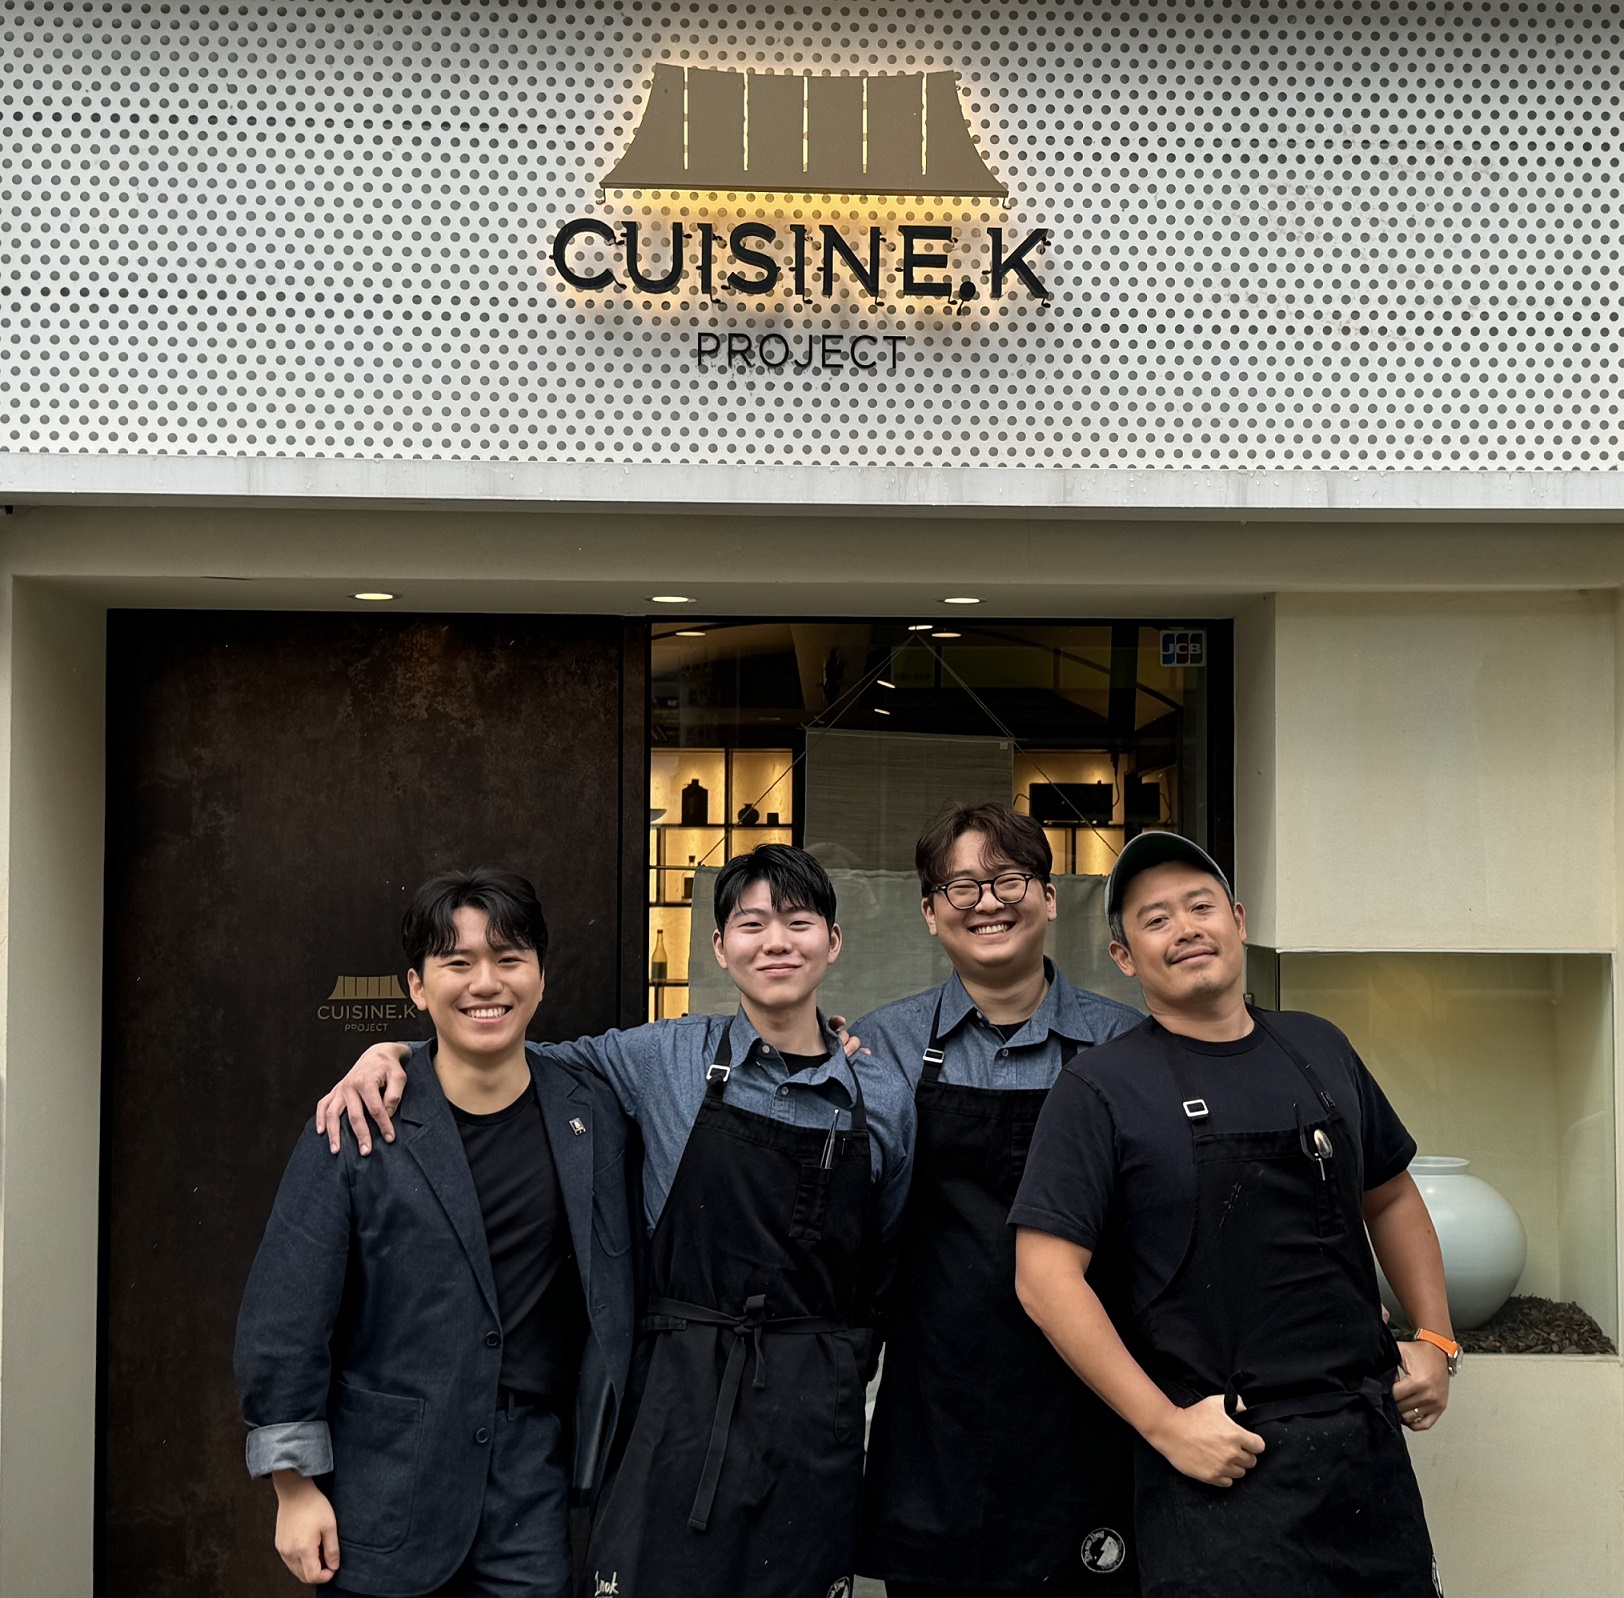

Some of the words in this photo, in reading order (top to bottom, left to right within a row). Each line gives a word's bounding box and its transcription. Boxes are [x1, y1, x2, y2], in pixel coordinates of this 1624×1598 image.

[552, 216, 1051, 301] CUISINE.K
[697, 331, 908, 371] PROJECT
[1162, 642, 1202, 655] JCB
[317, 1004, 416, 1020] CUISINE.K
